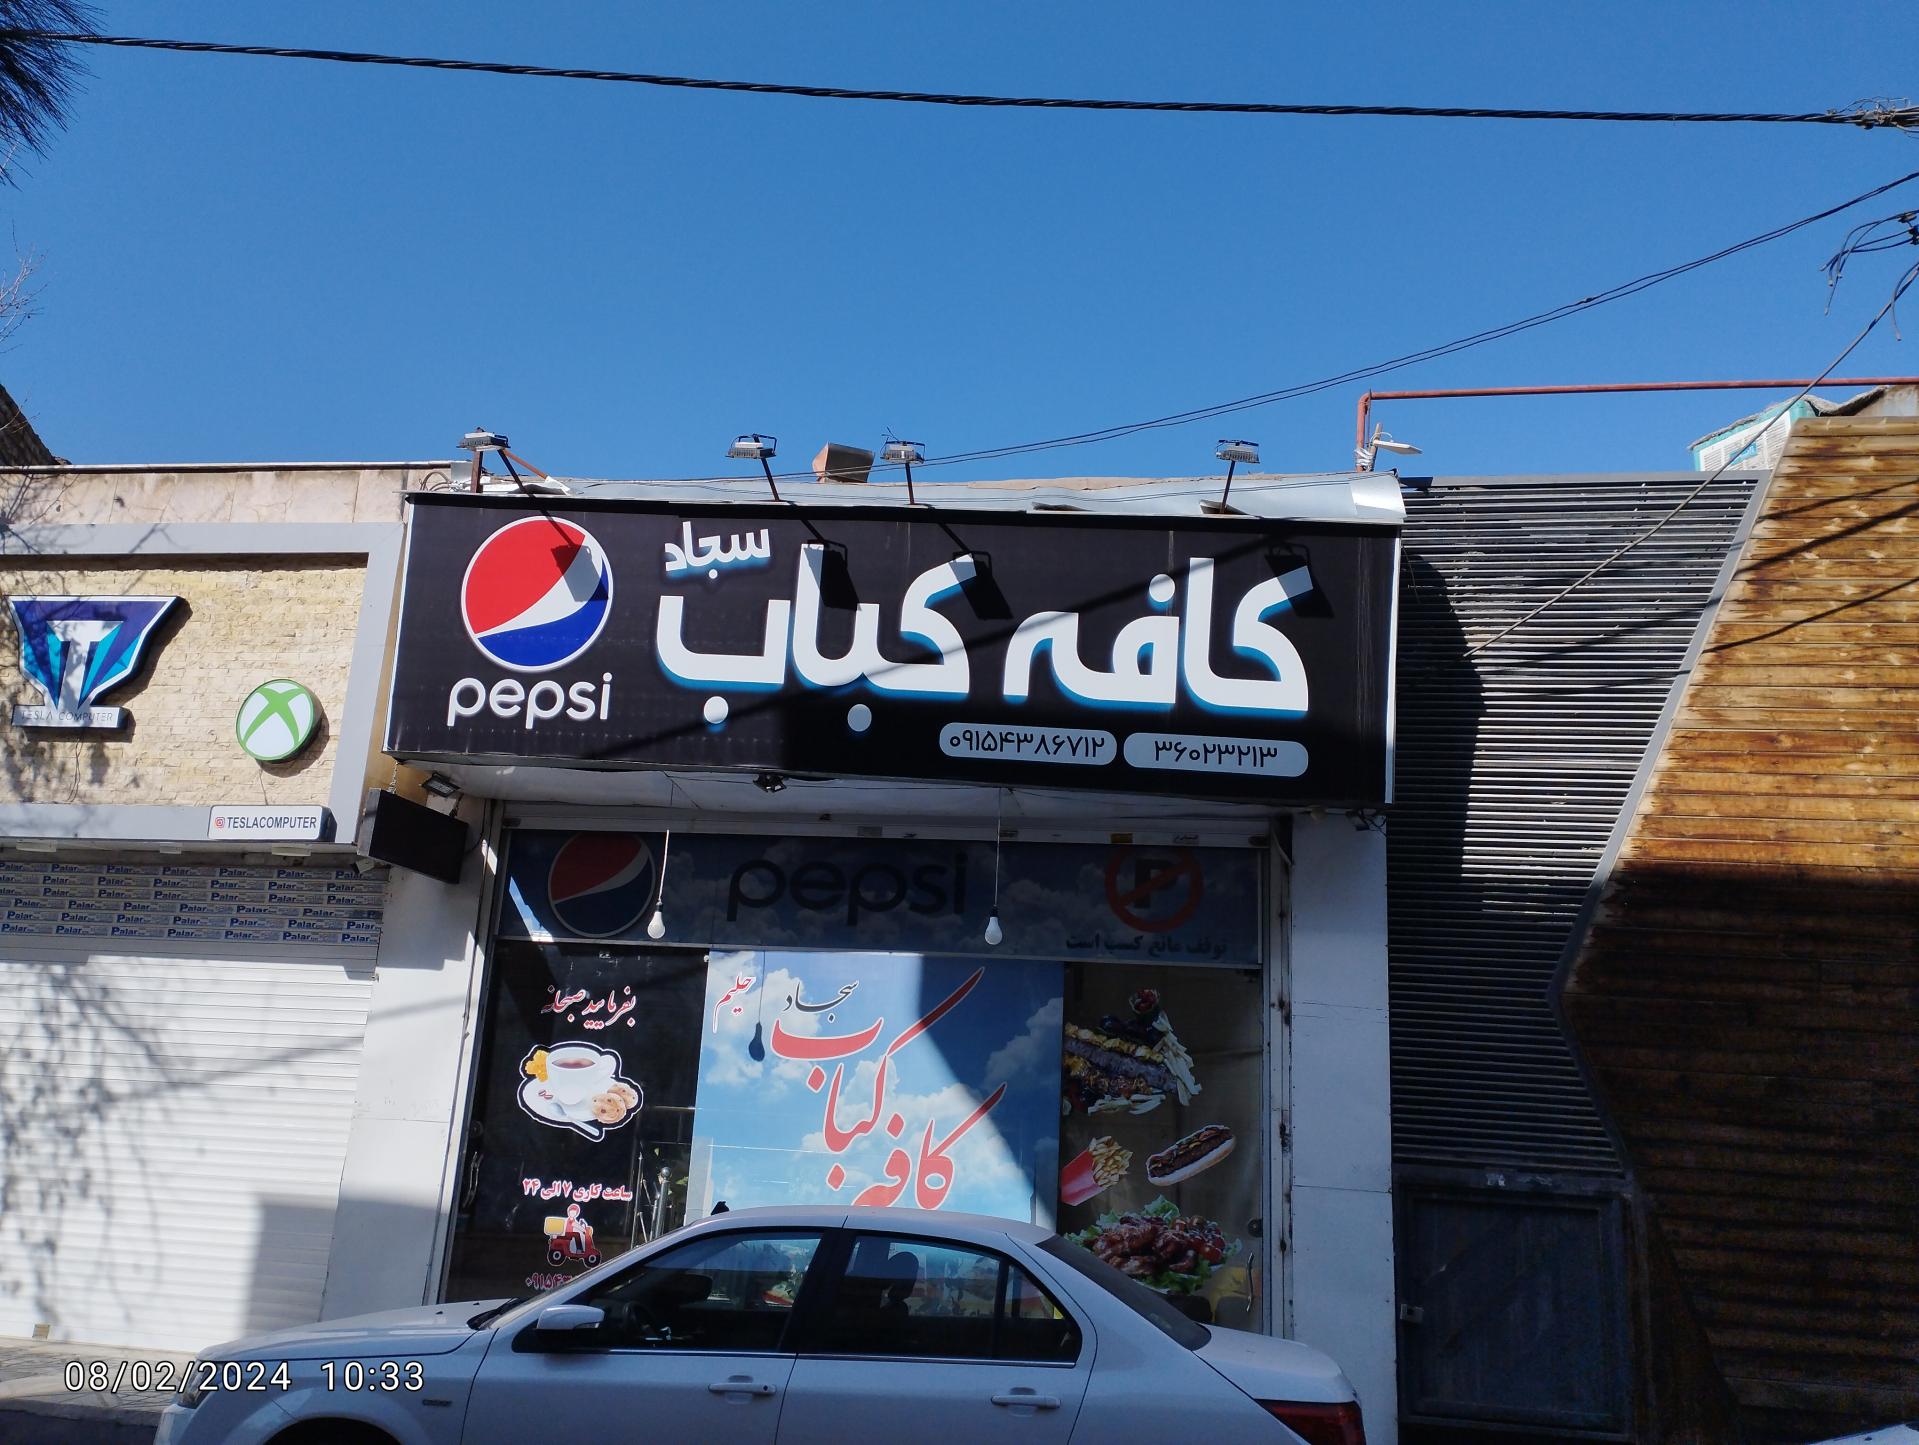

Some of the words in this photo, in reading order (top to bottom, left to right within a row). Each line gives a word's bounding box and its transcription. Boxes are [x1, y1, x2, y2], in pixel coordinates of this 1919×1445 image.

[665, 521, 771, 579] سجاد
[656, 543, 977, 733] کباب
[1003, 556, 1314, 714] کافه
[21, 710, 54, 721] TESLA
[58, 711, 113, 722] COMPUTER
[447, 672, 613, 729] pepsi
[950, 729, 1105, 758] ۰۹۱۵۴۳۸۶۷۱۲
[1154, 740, 1278, 768] ۳۶۰۲۳۲۱۳
[227, 815, 317, 829] TESLACOMPUTER
[726, 852, 968, 928] pepsi
[581, 984, 637, 1028] بفرمایید
[712, 971, 756, 1033] حلیم
[783, 979, 860, 1023] سجاد
[770, 966, 985, 1191] کباب
[522, 1178, 541, 1197] ۲۴
[540, 1180, 562, 1201] الی
[562, 1179, 573, 1199] ۷
[572, 1183, 603, 1203] کاری
[602, 1185, 634, 1202] ساعت
